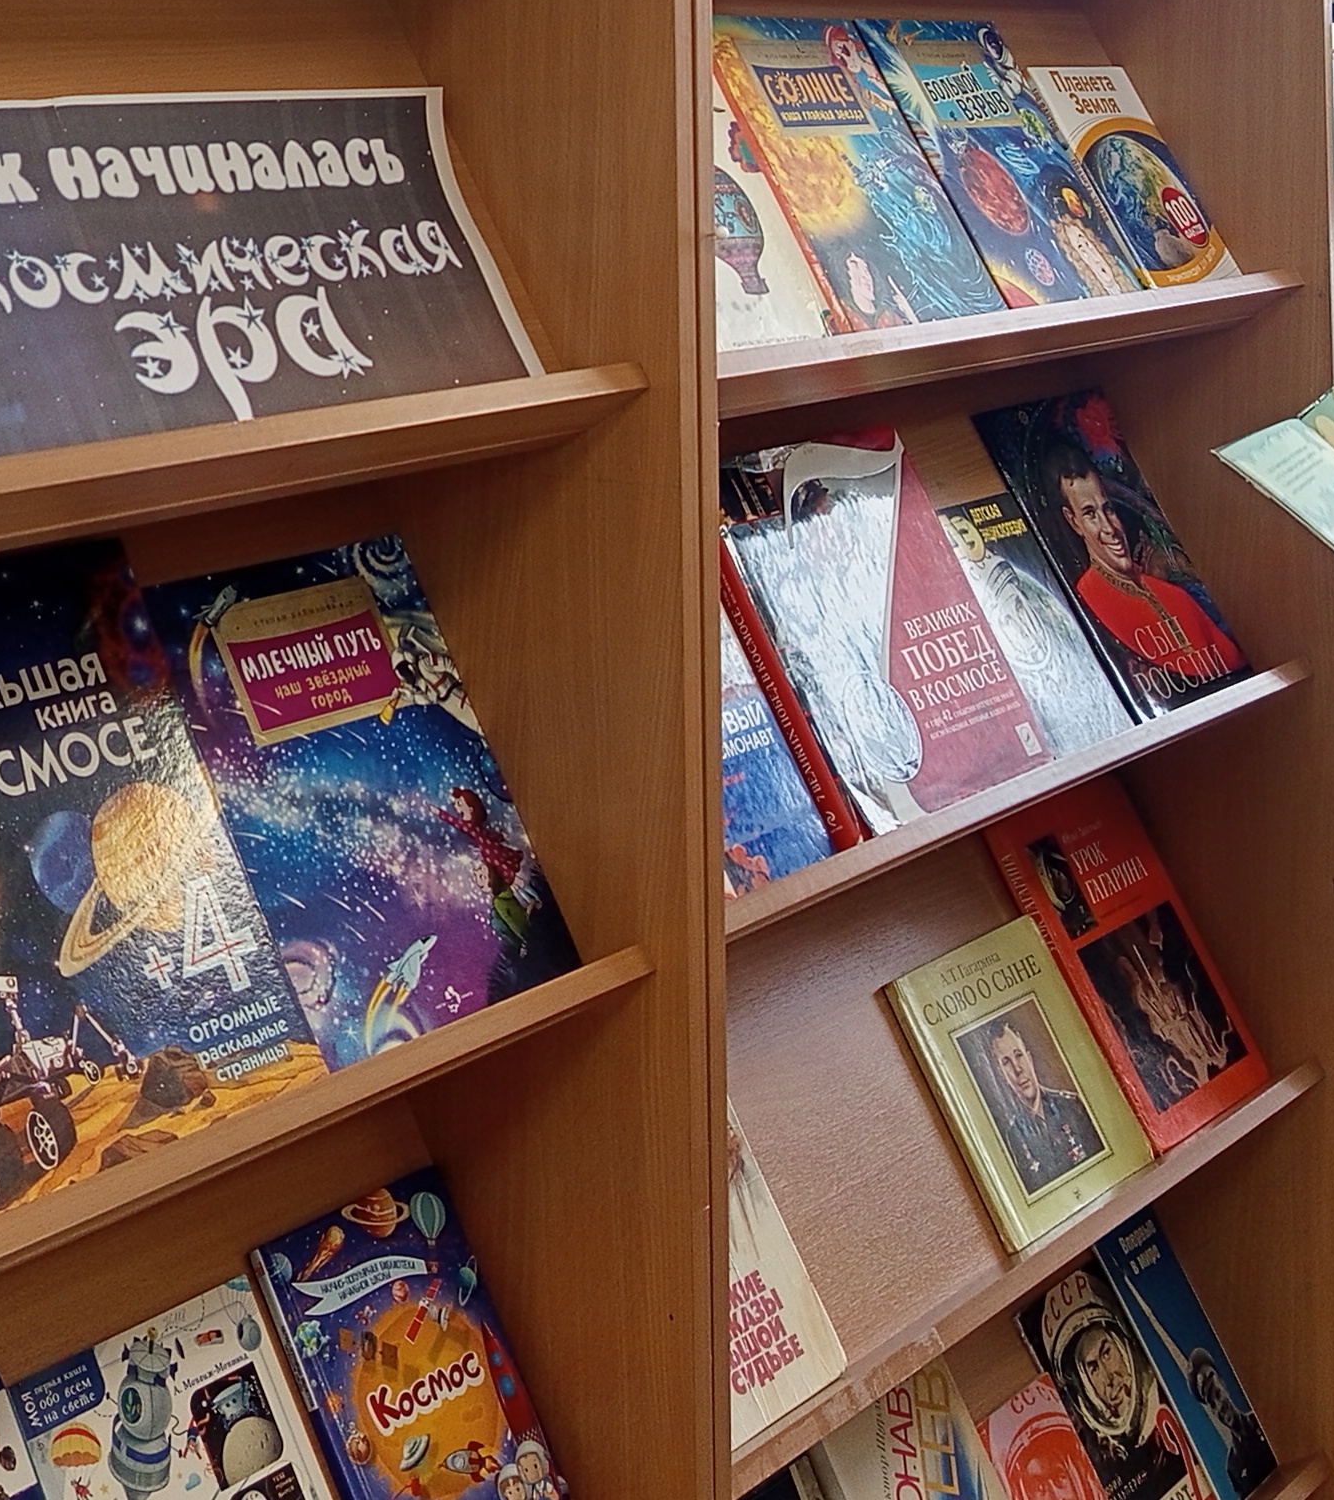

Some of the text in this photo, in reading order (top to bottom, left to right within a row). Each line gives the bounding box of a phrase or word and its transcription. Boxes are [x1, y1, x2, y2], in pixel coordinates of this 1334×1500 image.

[762, 70, 855, 108] СОЛНЦЕ
[924, 61, 983, 103] БОЛЬШОЙ
[1048, 70, 1117, 93] Планета
[955, 90, 1011, 123] ВЗРЫВ
[1069, 93, 1121, 114] Земля
[47, 137, 405, 200] начиналась
[1165, 196, 1198, 229] 100
[114, 286, 373, 421] эра
[731, 605, 767, 673] КОСМОСЕ
[903, 601, 978, 640] ВЕЛИКИХ
[1134, 615, 1192, 661] СЫН
[240, 627, 382, 683] МЛЕЧНЫЙ ПУТЬ
[900, 623, 998, 681] ПОБЕД
[1132, 643, 1232, 700] РОССИИ
[274, 659, 373, 700] наш звёздный
[310, 687, 354, 710] город
[908, 659, 1008, 712] В КОСМОСЕ
[35, 691, 118, 731] книга
[722, 699, 768, 736] ВЫЙ
[767, 679, 793, 726] ПОБЕД
[942, 706, 954, 722] 42
[786, 726, 822, 791] ВЕЛИКИХ
[1070, 841, 1108, 876] УРОК
[1084, 855, 1149, 905] ГАГАРИНА
[922, 953, 1042, 1027] СЛОВО О СЫНЕ
[189, 995, 282, 1044] ОГРОМНЫЕ
[197, 1017, 290, 1070] раскладные
[216, 1044, 290, 1083] страницы
[1118, 1218, 1158, 1256] Впервые
[1042, 1274, 1088, 1339] СССР
[62, 1362, 89, 1382] книга
[731, 1332, 805, 1396] СУДЬБЕ
[38, 1376, 93, 1411] обо всем
[43, 1390, 98, 1426] на свете
[368, 1352, 482, 1430] Космос
